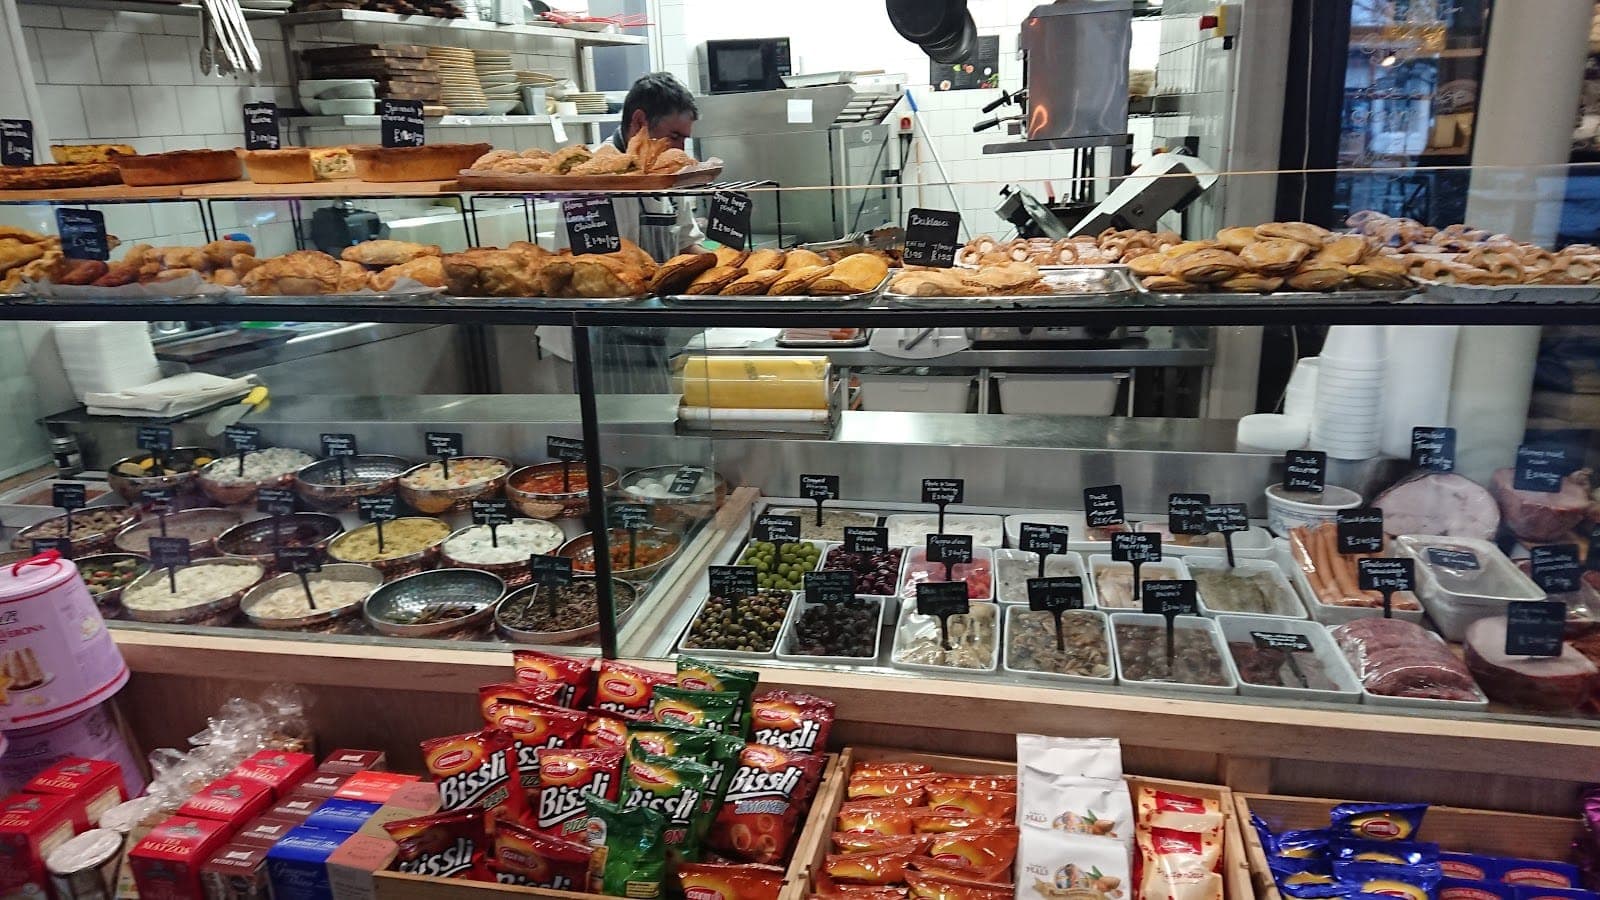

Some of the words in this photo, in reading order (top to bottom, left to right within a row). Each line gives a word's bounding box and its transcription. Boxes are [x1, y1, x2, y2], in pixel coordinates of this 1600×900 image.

[35, 778, 81, 790] MATZOS
[439, 750, 506, 809] Bissli
[726, 766, 803, 796] Bissli
[540, 772, 611, 820] Bissli
[142, 842, 193, 855] MATZOS
